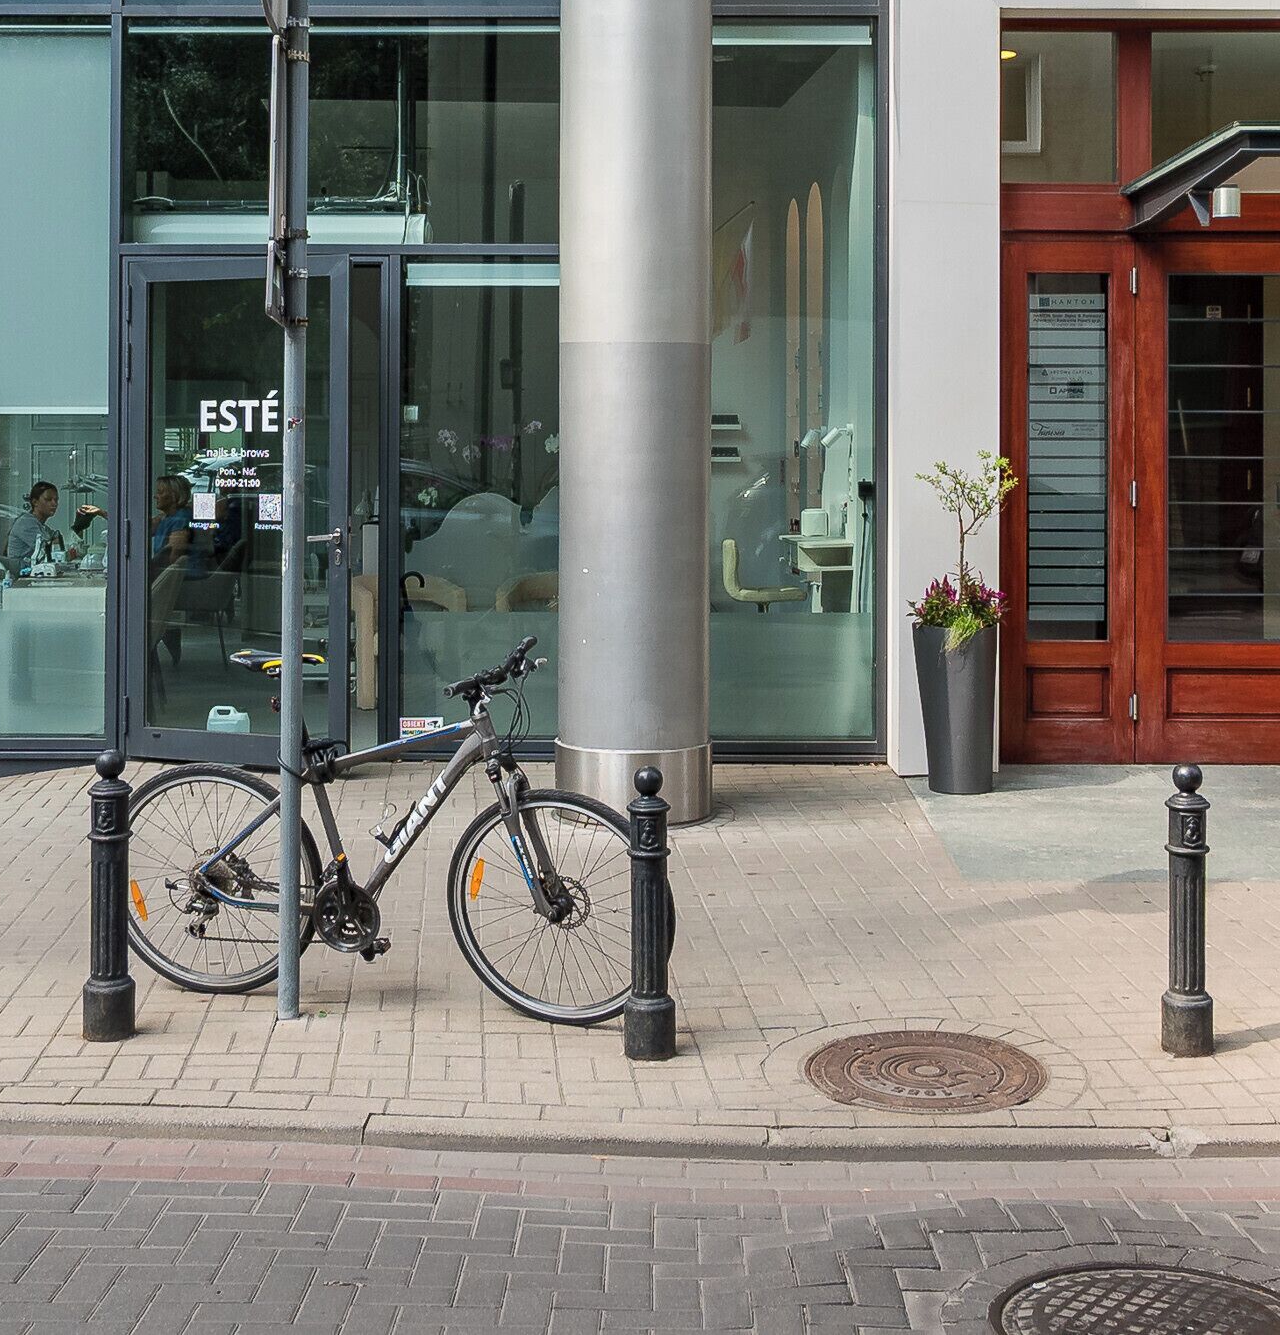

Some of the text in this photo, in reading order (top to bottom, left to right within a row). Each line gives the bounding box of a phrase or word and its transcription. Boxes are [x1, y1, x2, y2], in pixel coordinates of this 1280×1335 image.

[200, 389, 279, 433] ESTÉ
[206, 447, 270, 458] nails & brows
[214, 478, 261, 488] 09:00-21:00
[384, 768, 447, 864] GIANT
